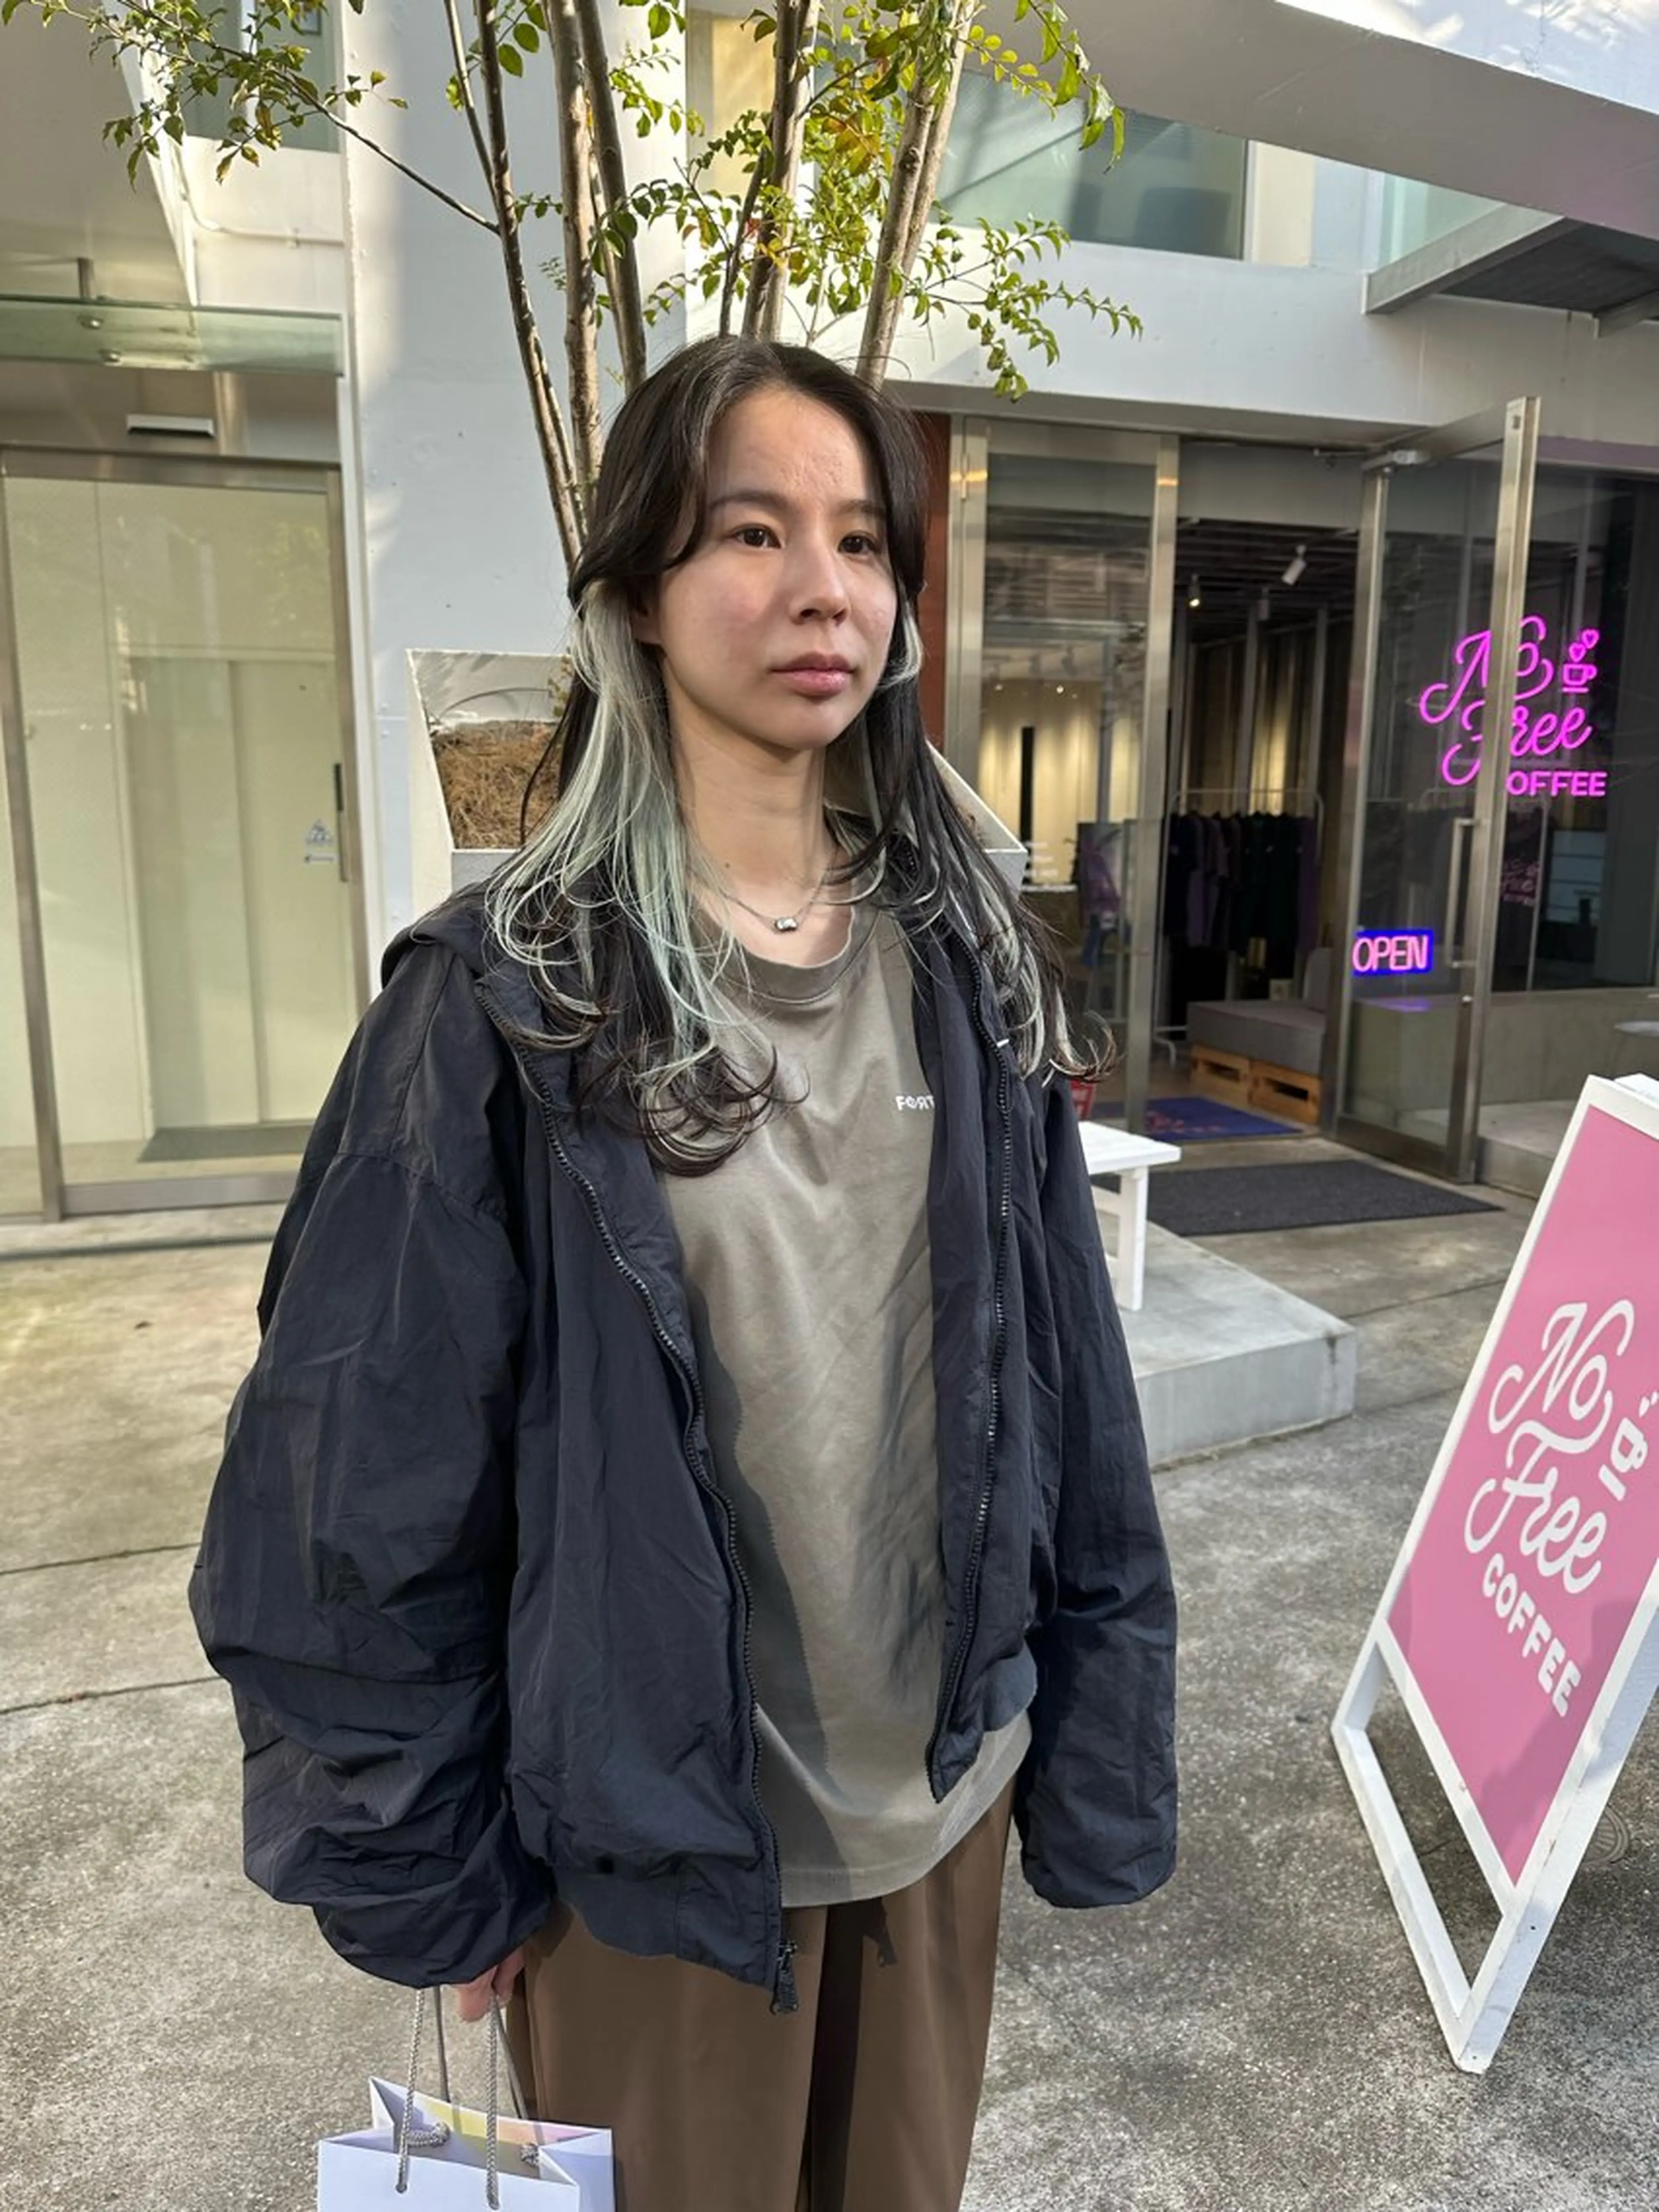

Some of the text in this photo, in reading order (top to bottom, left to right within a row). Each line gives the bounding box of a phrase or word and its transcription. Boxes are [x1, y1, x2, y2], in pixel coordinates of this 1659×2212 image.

[1506, 770, 1608, 797] OFFEE
[1352, 934, 1429, 972] OPEN
[1488, 1299, 1635, 1434] No
[1464, 1389, 1614, 1595] Free
[1482, 1552, 1582, 1718] COFFEE
